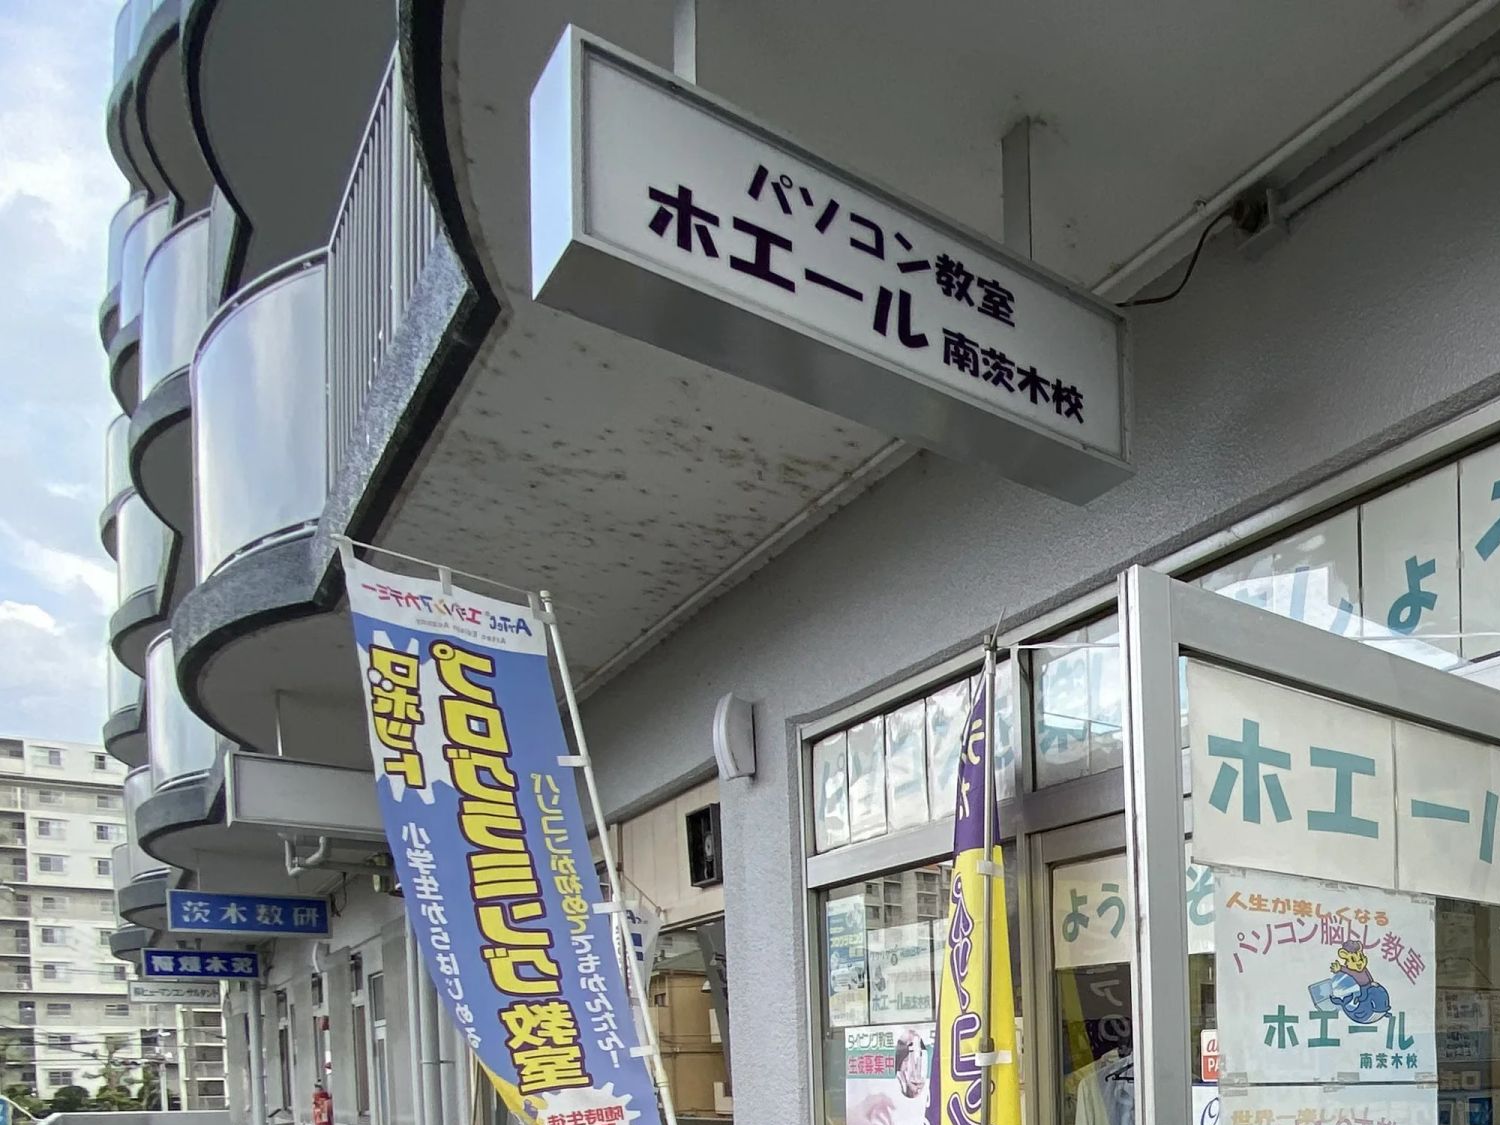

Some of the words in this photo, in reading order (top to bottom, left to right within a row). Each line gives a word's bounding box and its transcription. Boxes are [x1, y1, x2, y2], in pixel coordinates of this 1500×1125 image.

[648, 184, 929, 348] ホエール
[747, 164, 1016, 328] パソコン教室
[942, 327, 1085, 424] 南茨木校
[182, 901, 319, 928] 茨木数研
[1062, 883, 1126, 942] よう
[1226, 891, 1390, 926] 人生が楽しくなる
[1233, 915, 1426, 985] パソコン脳トレ教室
[1263, 1004, 1415, 1050] ホエール
[1360, 1052, 1418, 1069] 南茨木校
